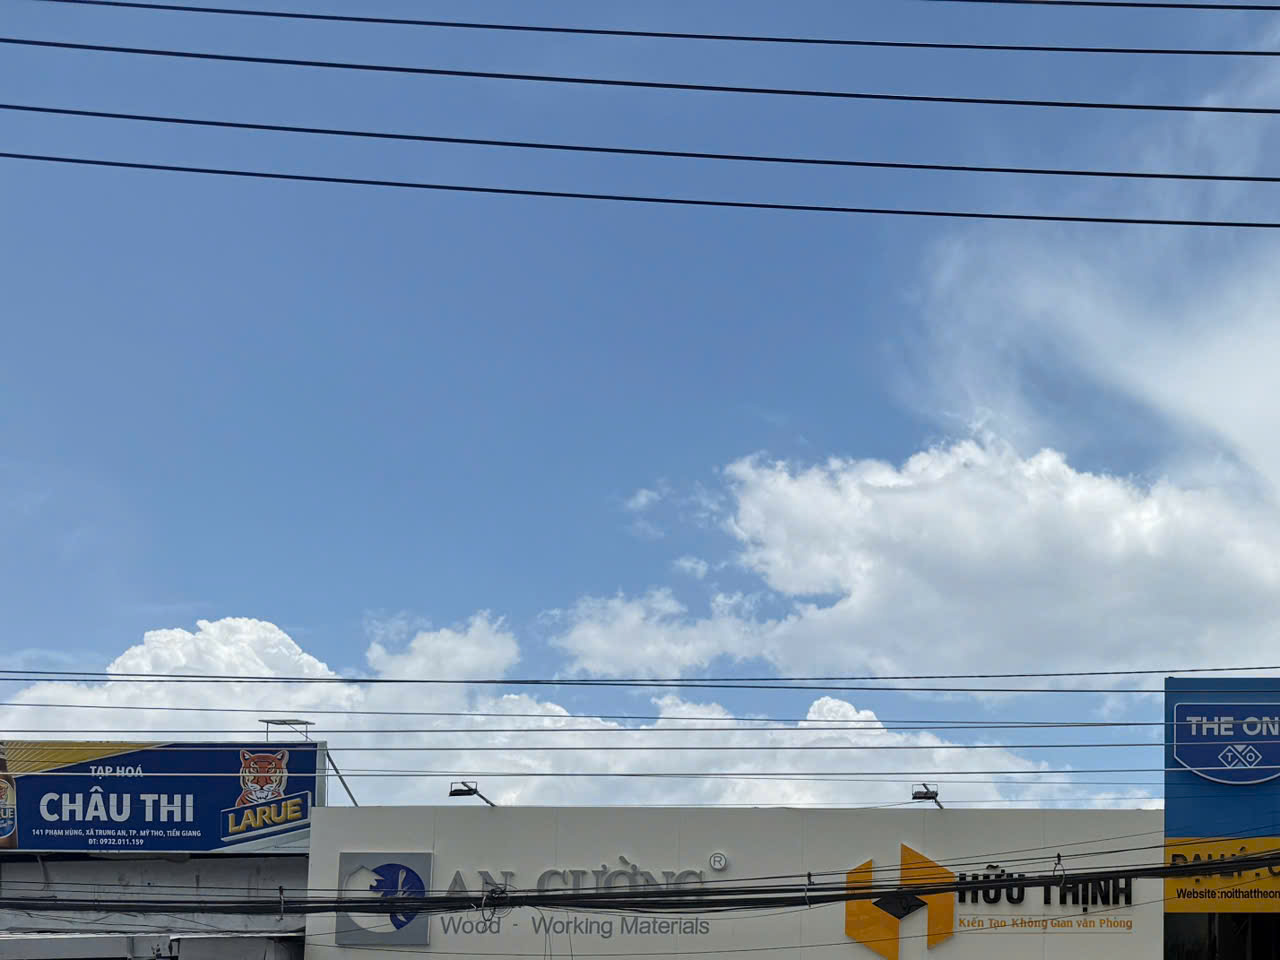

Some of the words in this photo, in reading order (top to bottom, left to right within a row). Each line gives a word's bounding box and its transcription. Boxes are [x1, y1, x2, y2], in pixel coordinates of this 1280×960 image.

[1186, 716, 1234, 736] THE
[90, 766, 114, 779] TẠP
[116, 764, 144, 778] HOÁ
[39, 785, 131, 822] CHÂU
[140, 794, 193, 822] THI
[228, 799, 303, 833] LARUE
[32, 828, 44, 836] 141
[95, 829, 116, 837] TRUNG
[441, 916, 501, 935] Wood
[531, 916, 613, 938] Working
[621, 916, 710, 935] Materials
